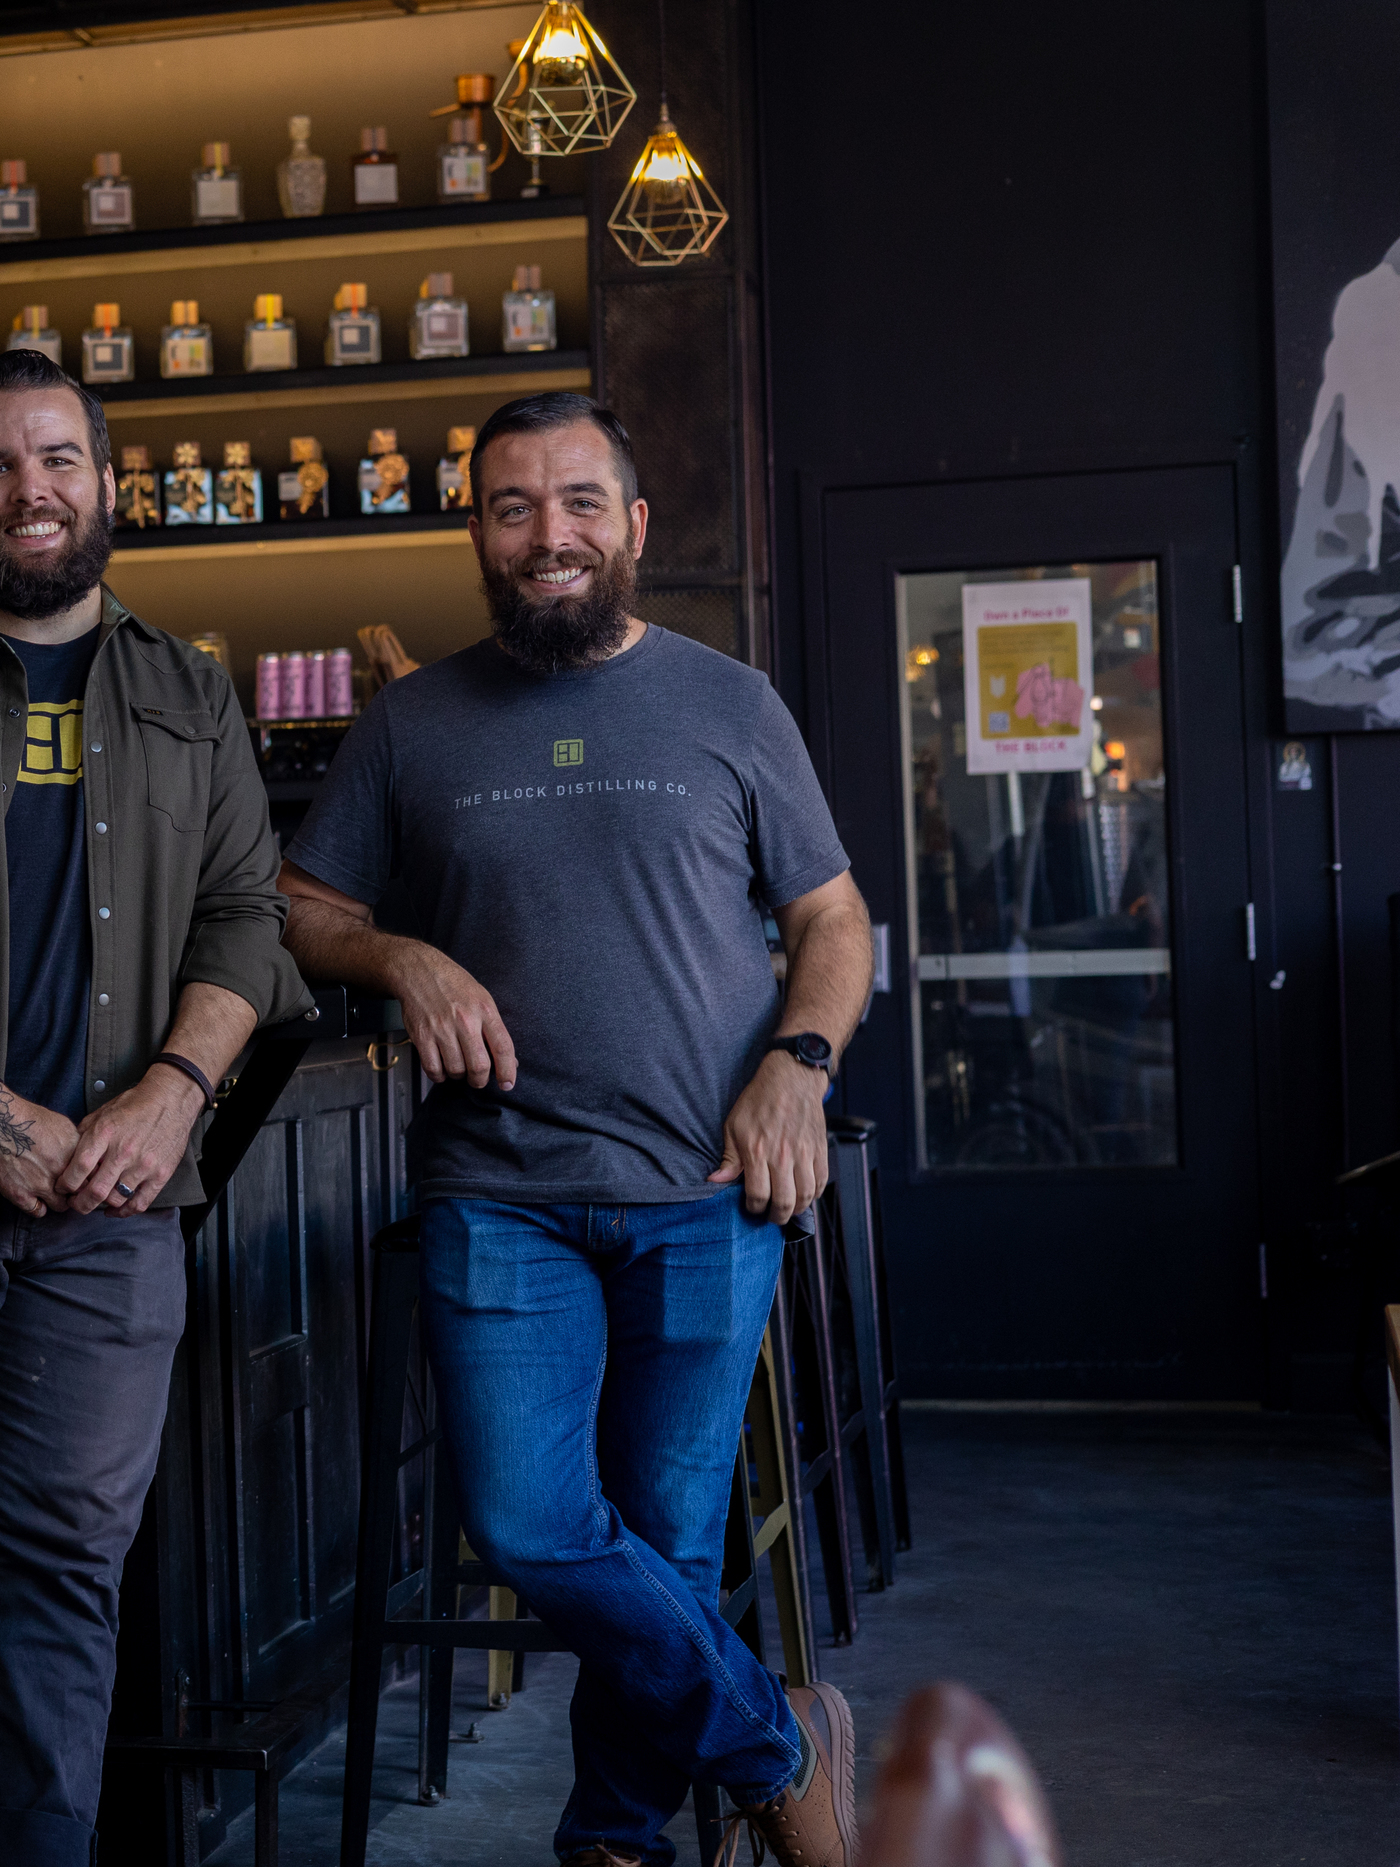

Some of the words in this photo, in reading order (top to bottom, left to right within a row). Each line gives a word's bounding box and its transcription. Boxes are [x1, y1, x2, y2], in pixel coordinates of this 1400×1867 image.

[454, 793, 482, 809] THE
[492, 785, 547, 801] BLOCK
[556, 779, 657, 796] DISTILLING
[666, 782, 692, 797] CO.
